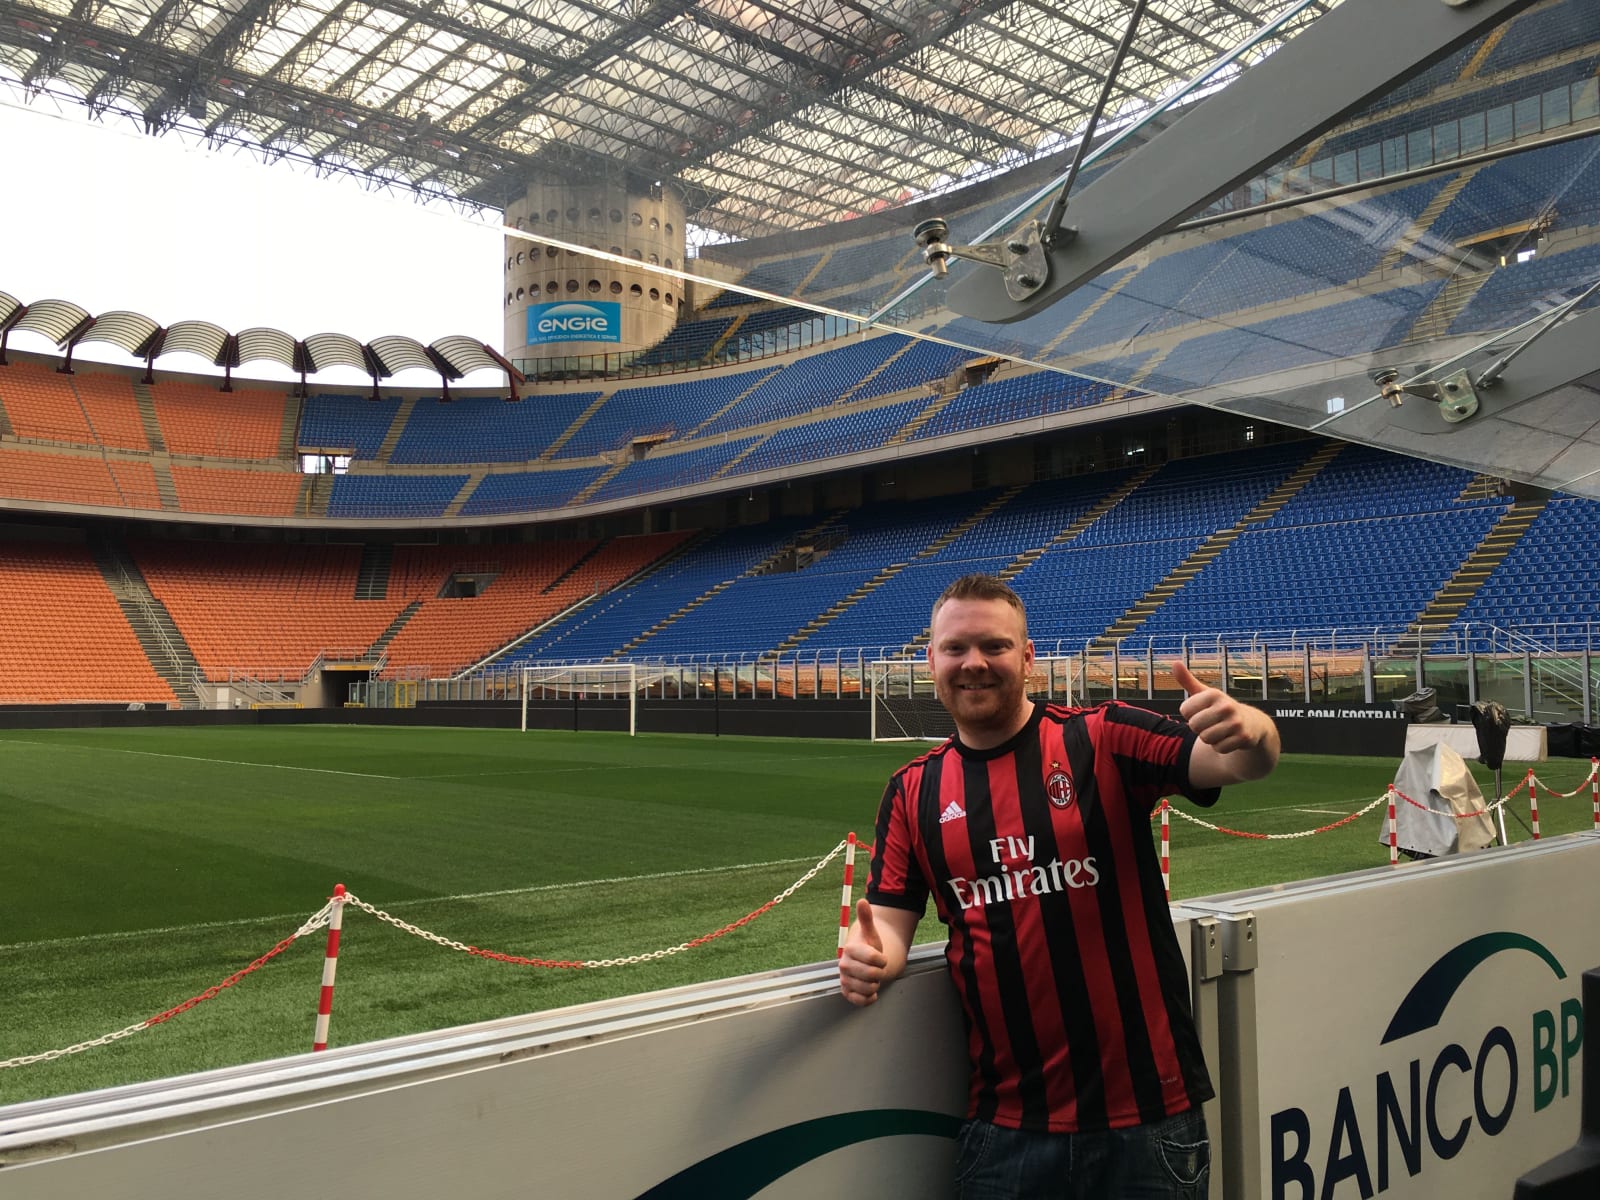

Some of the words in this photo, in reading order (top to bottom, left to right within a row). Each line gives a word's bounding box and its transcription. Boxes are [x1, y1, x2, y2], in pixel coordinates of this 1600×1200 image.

[939, 810, 967, 824] adidas
[988, 835, 1035, 863] Fly
[947, 856, 1100, 910] Emirates
[1271, 1026, 1518, 1200] BANCO
